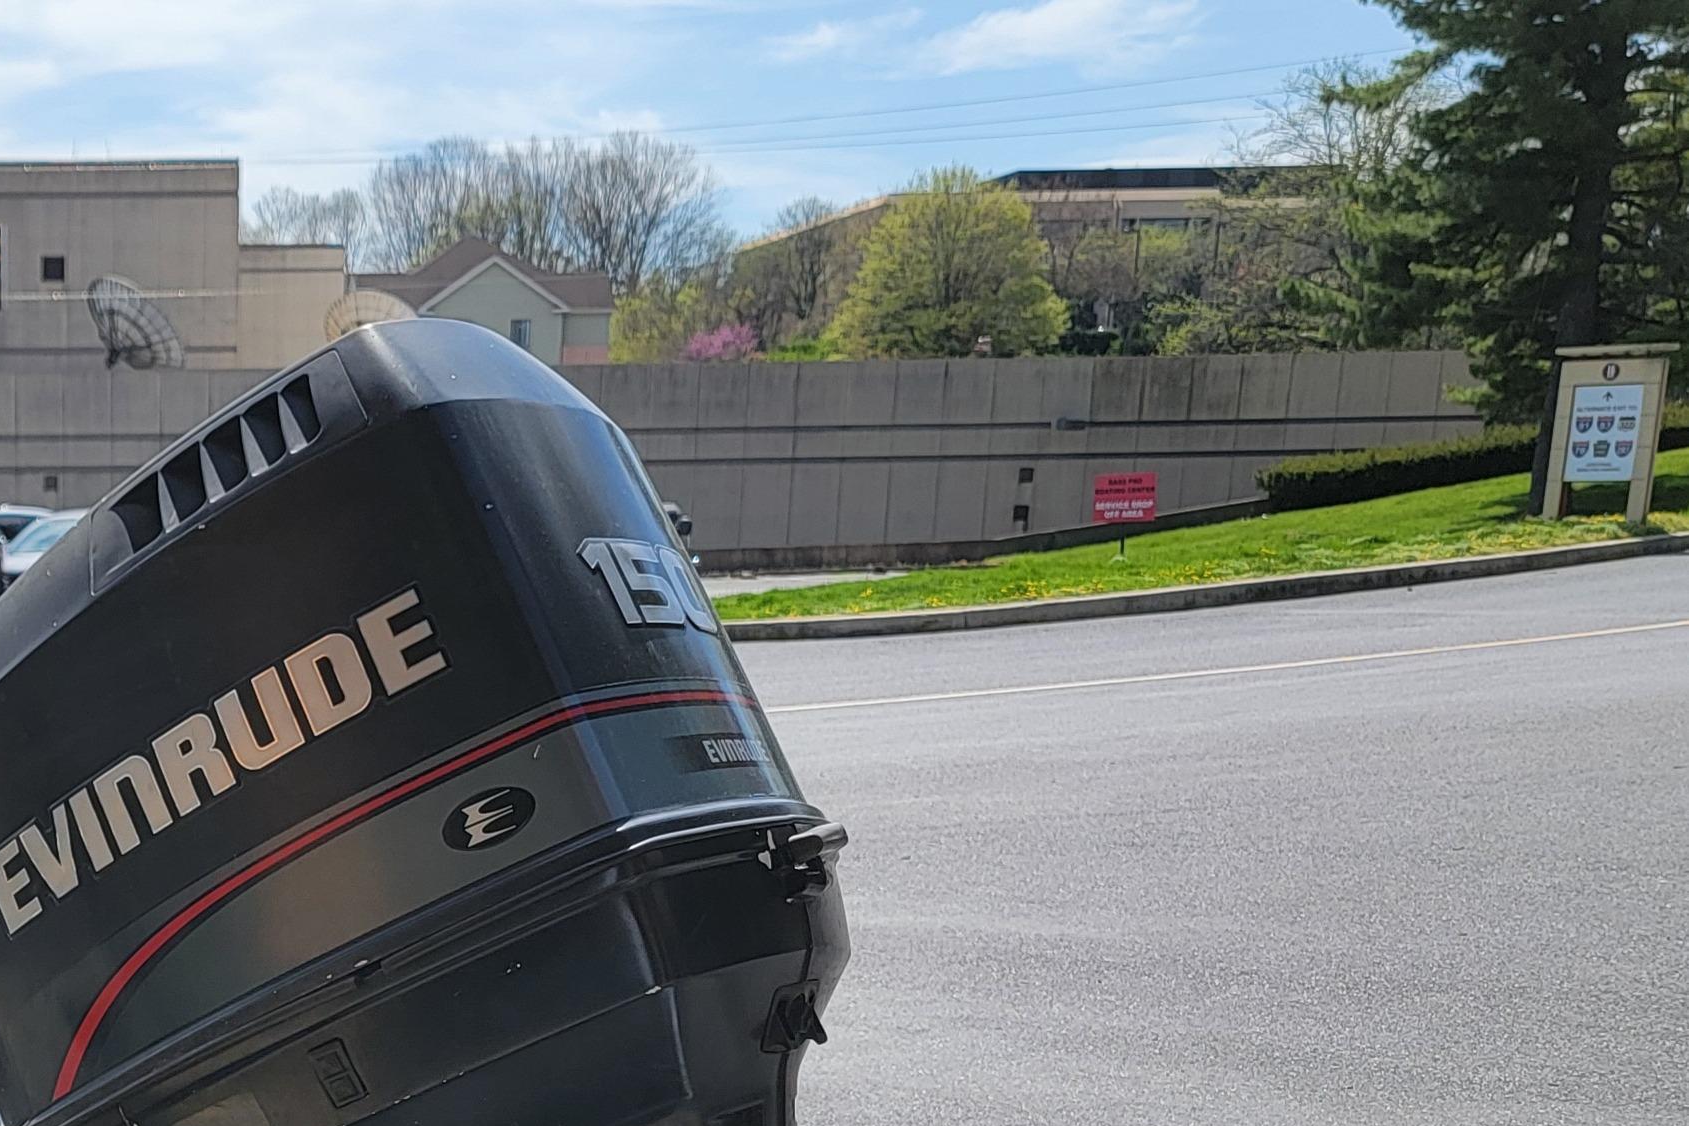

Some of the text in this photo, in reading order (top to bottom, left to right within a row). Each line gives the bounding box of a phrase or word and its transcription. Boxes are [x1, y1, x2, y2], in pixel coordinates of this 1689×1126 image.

[1094, 486, 1155, 495] BOATING CENTER
[1094, 500, 1154, 511] SERVICE DROP
[1103, 509, 1144, 519] OFF AREA
[702, 738, 771, 765] EVINRUDE
